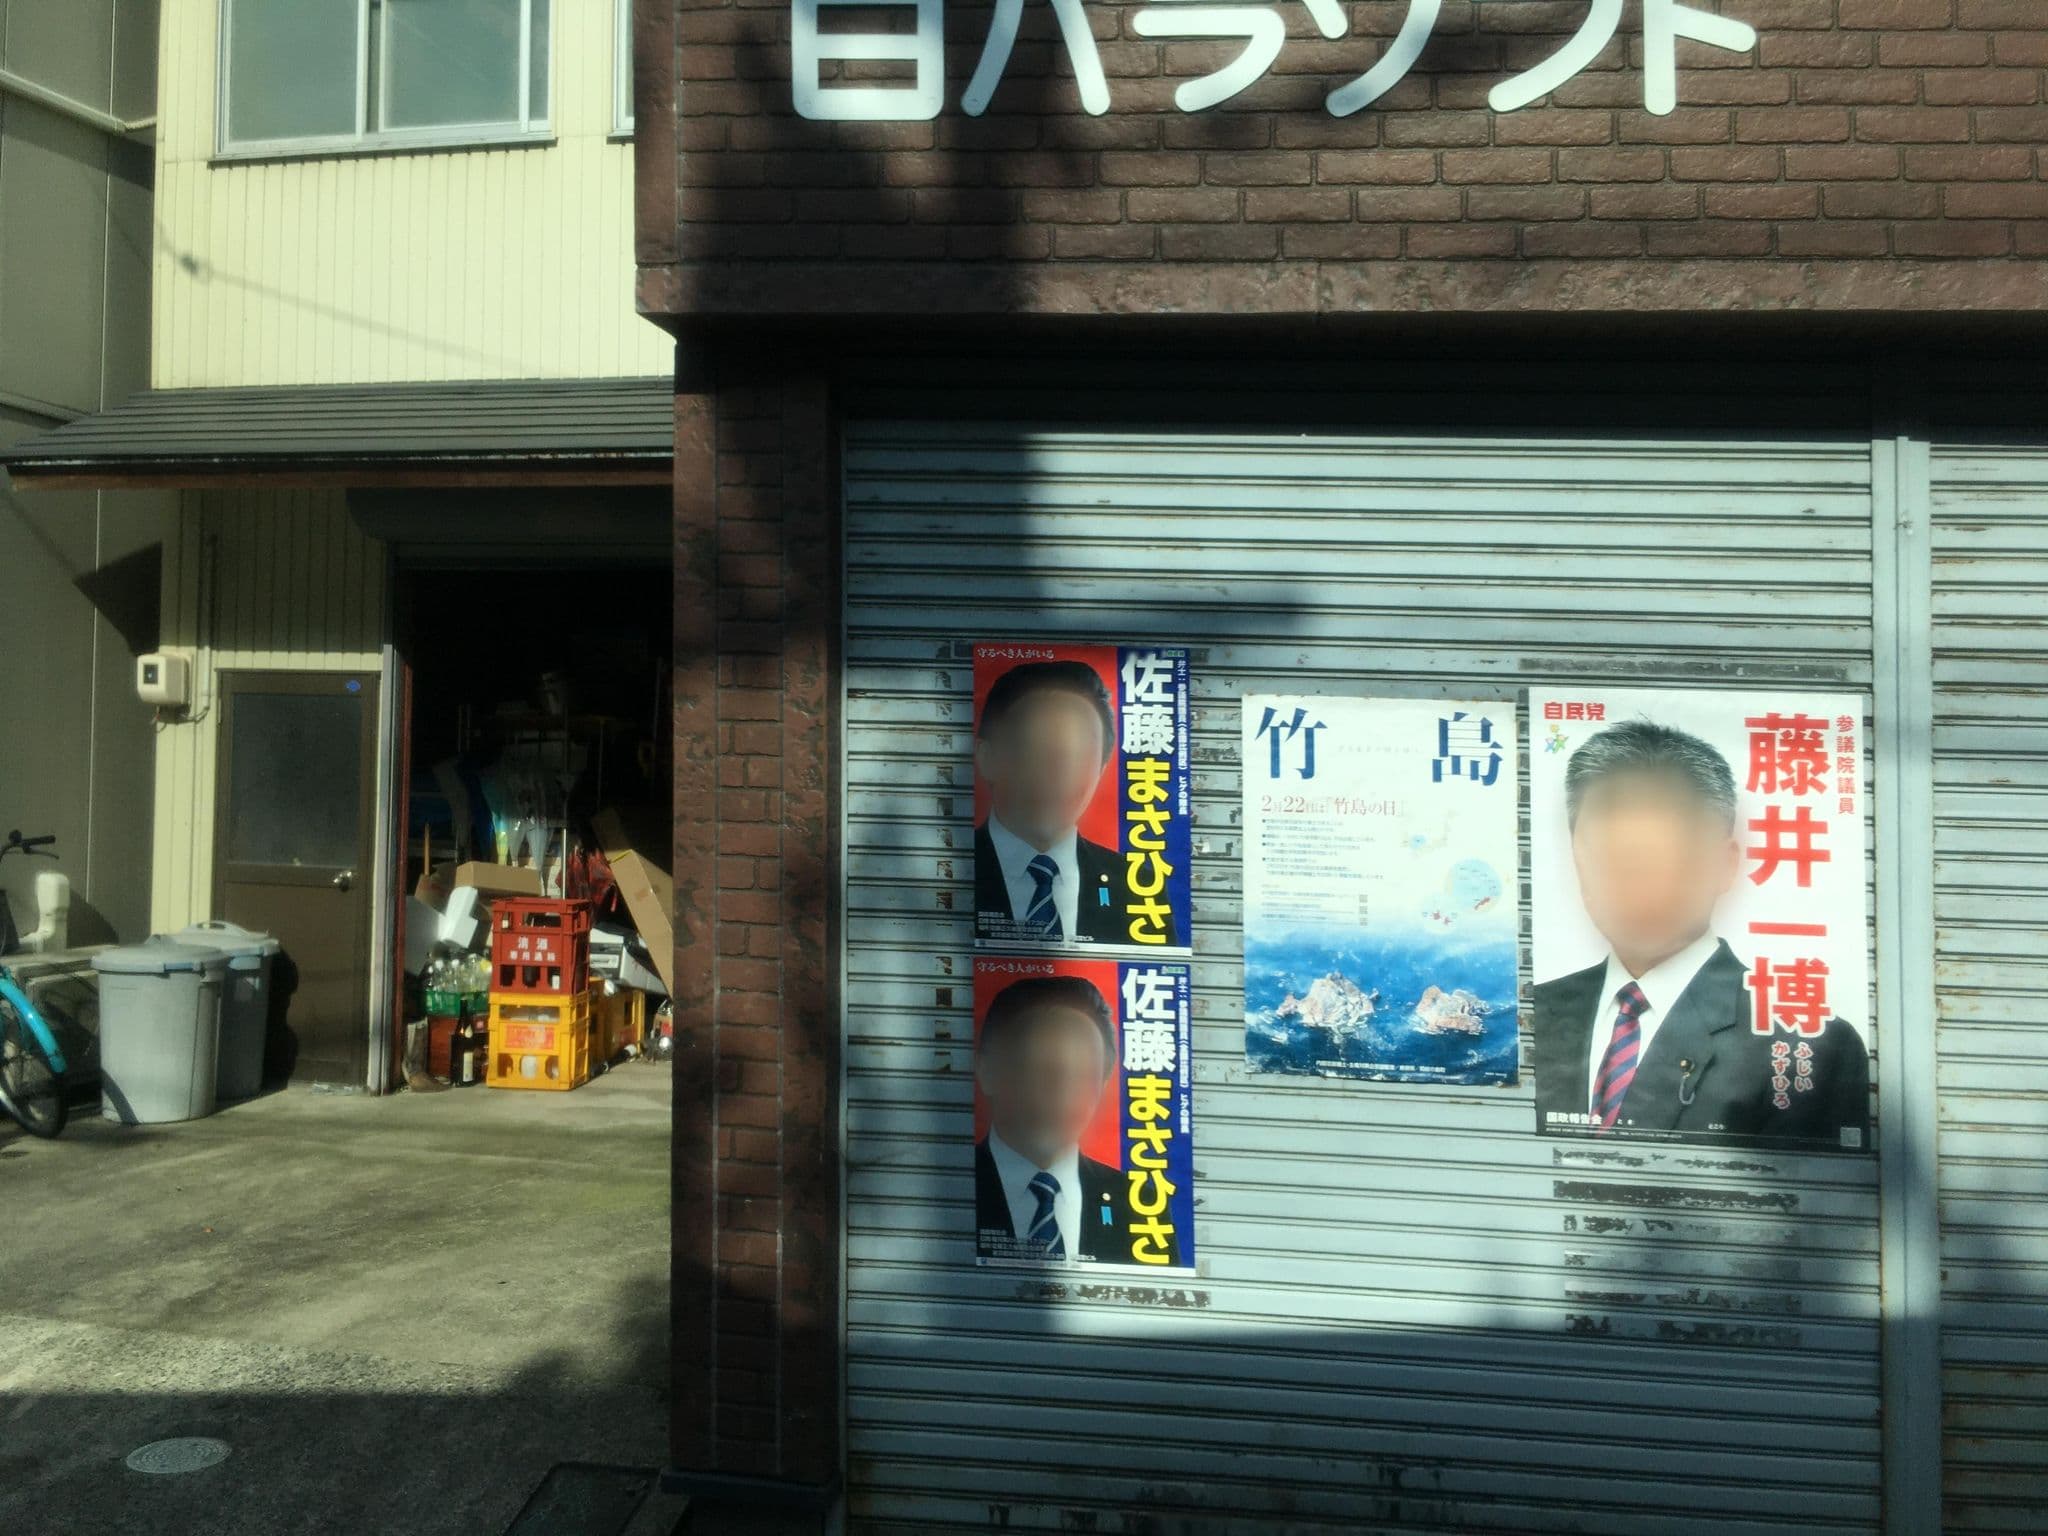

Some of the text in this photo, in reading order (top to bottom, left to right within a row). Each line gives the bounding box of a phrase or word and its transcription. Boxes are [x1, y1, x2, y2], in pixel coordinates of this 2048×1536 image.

[977, 648, 1055, 659] 守るべき人がいる
[1544, 701, 1605, 721] 自民党
[1121, 653, 1175, 944] 佐藤まさひさ
[1836, 714, 1856, 815] 参議院議員
[1744, 712, 1832, 1034] 藤井一博
[977, 962, 1054, 974] 守るべき人がいる
[1771, 1041, 1791, 1109] かずひろ
[1794, 1042, 1813, 1092] ふじい
[1122, 968, 1176, 1264] 佐藤まさひさ
